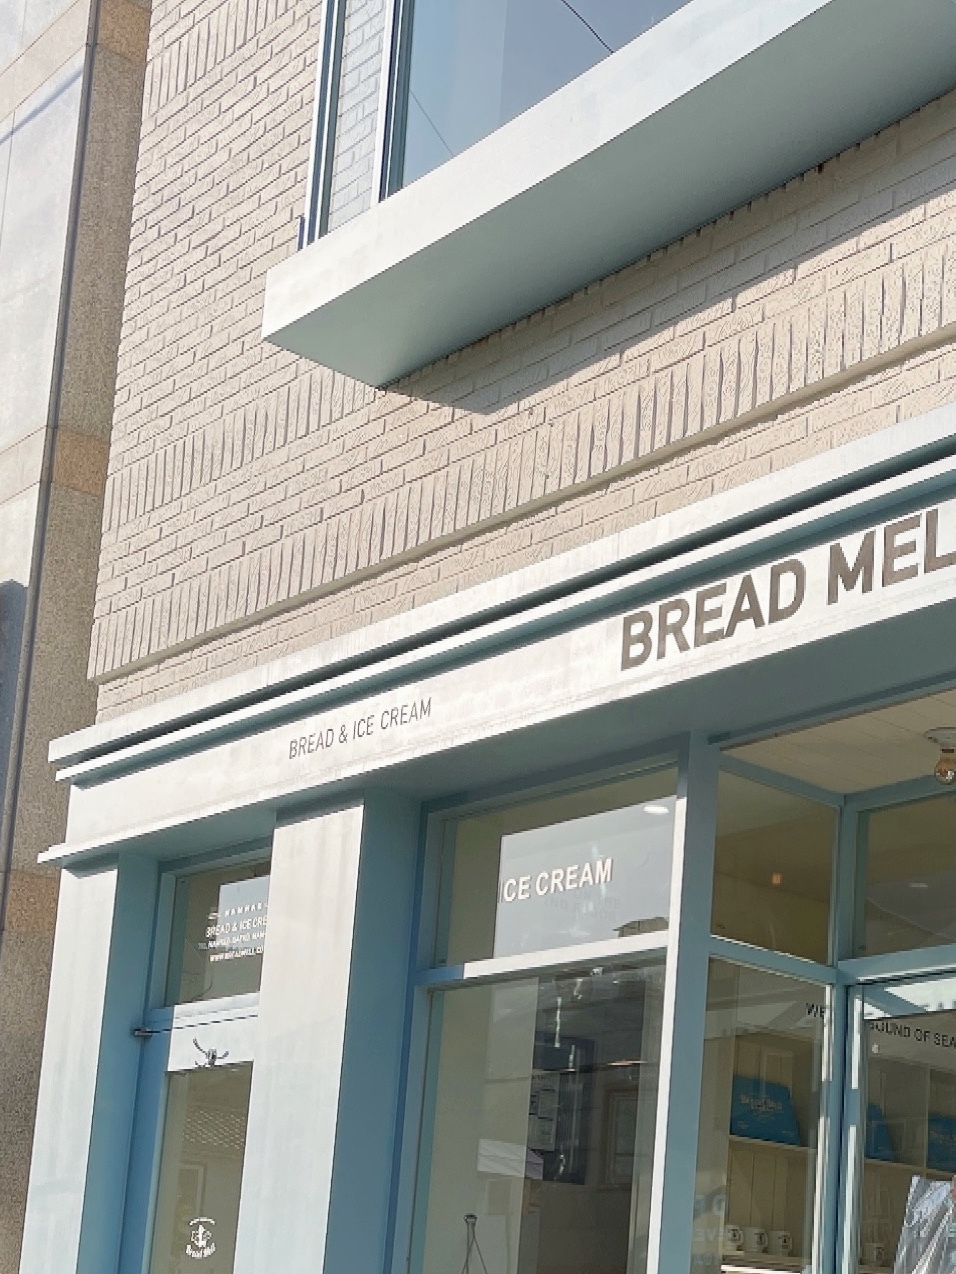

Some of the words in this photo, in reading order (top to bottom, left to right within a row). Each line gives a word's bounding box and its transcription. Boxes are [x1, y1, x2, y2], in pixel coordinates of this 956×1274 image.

[620, 559, 806, 672] BREAD
[289, 728, 335, 760] BREAD
[338, 724, 348, 744] &
[353, 714, 375, 740] ICE
[381, 697, 432, 730] CREAM
[535, 858, 613, 896] CREAM
[913, 1028, 931, 1042] OF
